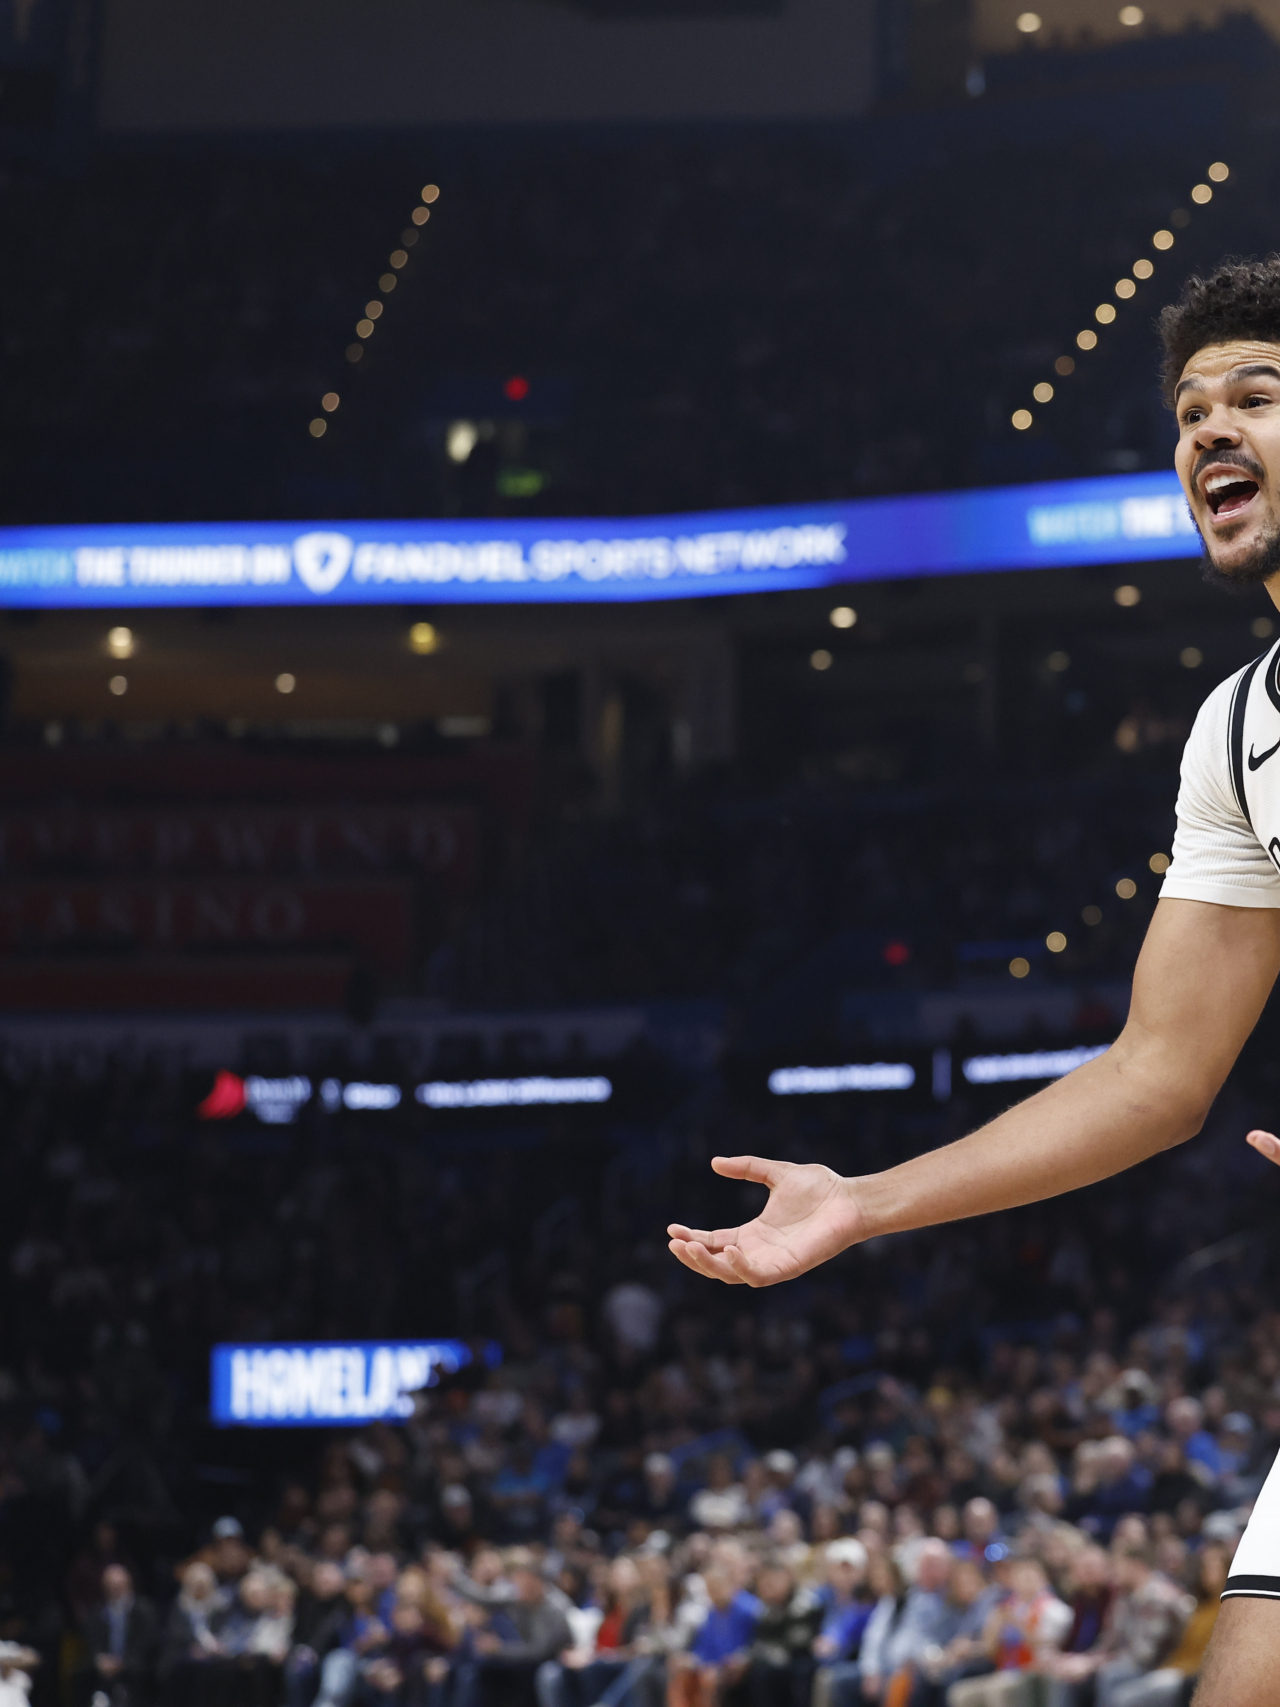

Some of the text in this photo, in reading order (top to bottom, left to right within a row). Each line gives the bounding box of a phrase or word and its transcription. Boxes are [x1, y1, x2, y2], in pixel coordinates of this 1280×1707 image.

[353, 521, 849, 583] FANDUEL SPORTS NETWORK
